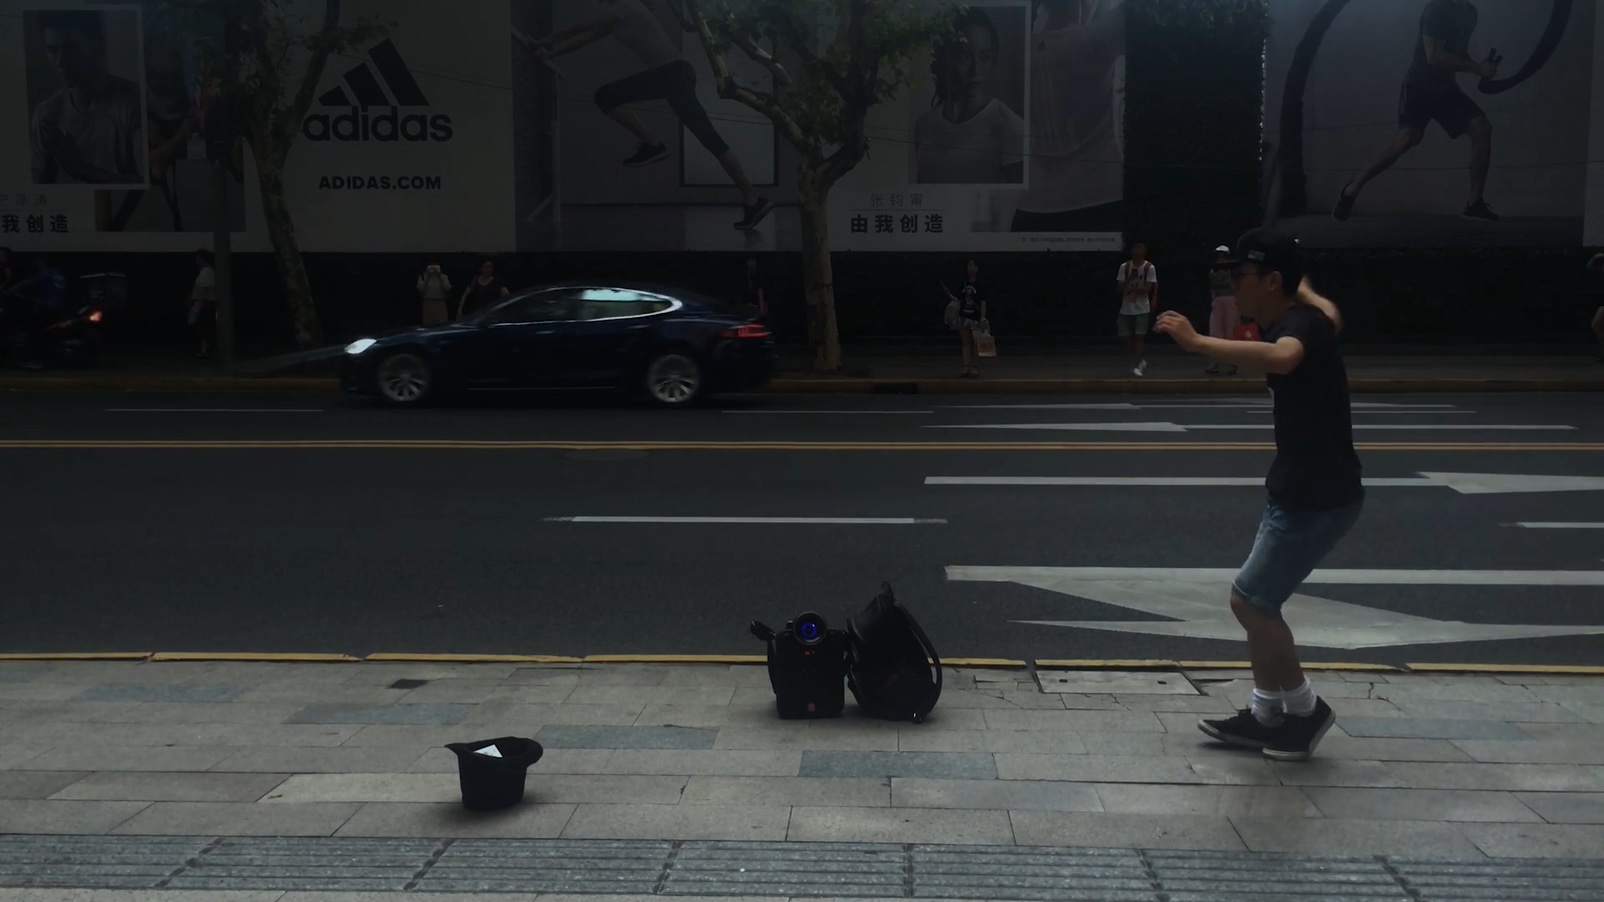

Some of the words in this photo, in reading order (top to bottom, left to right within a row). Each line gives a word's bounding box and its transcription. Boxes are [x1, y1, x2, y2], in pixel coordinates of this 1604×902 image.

[303, 106, 453, 141] adidas
[319, 176, 442, 190] ADIDAS.COM
[851, 214, 943, 233] 由我创造
